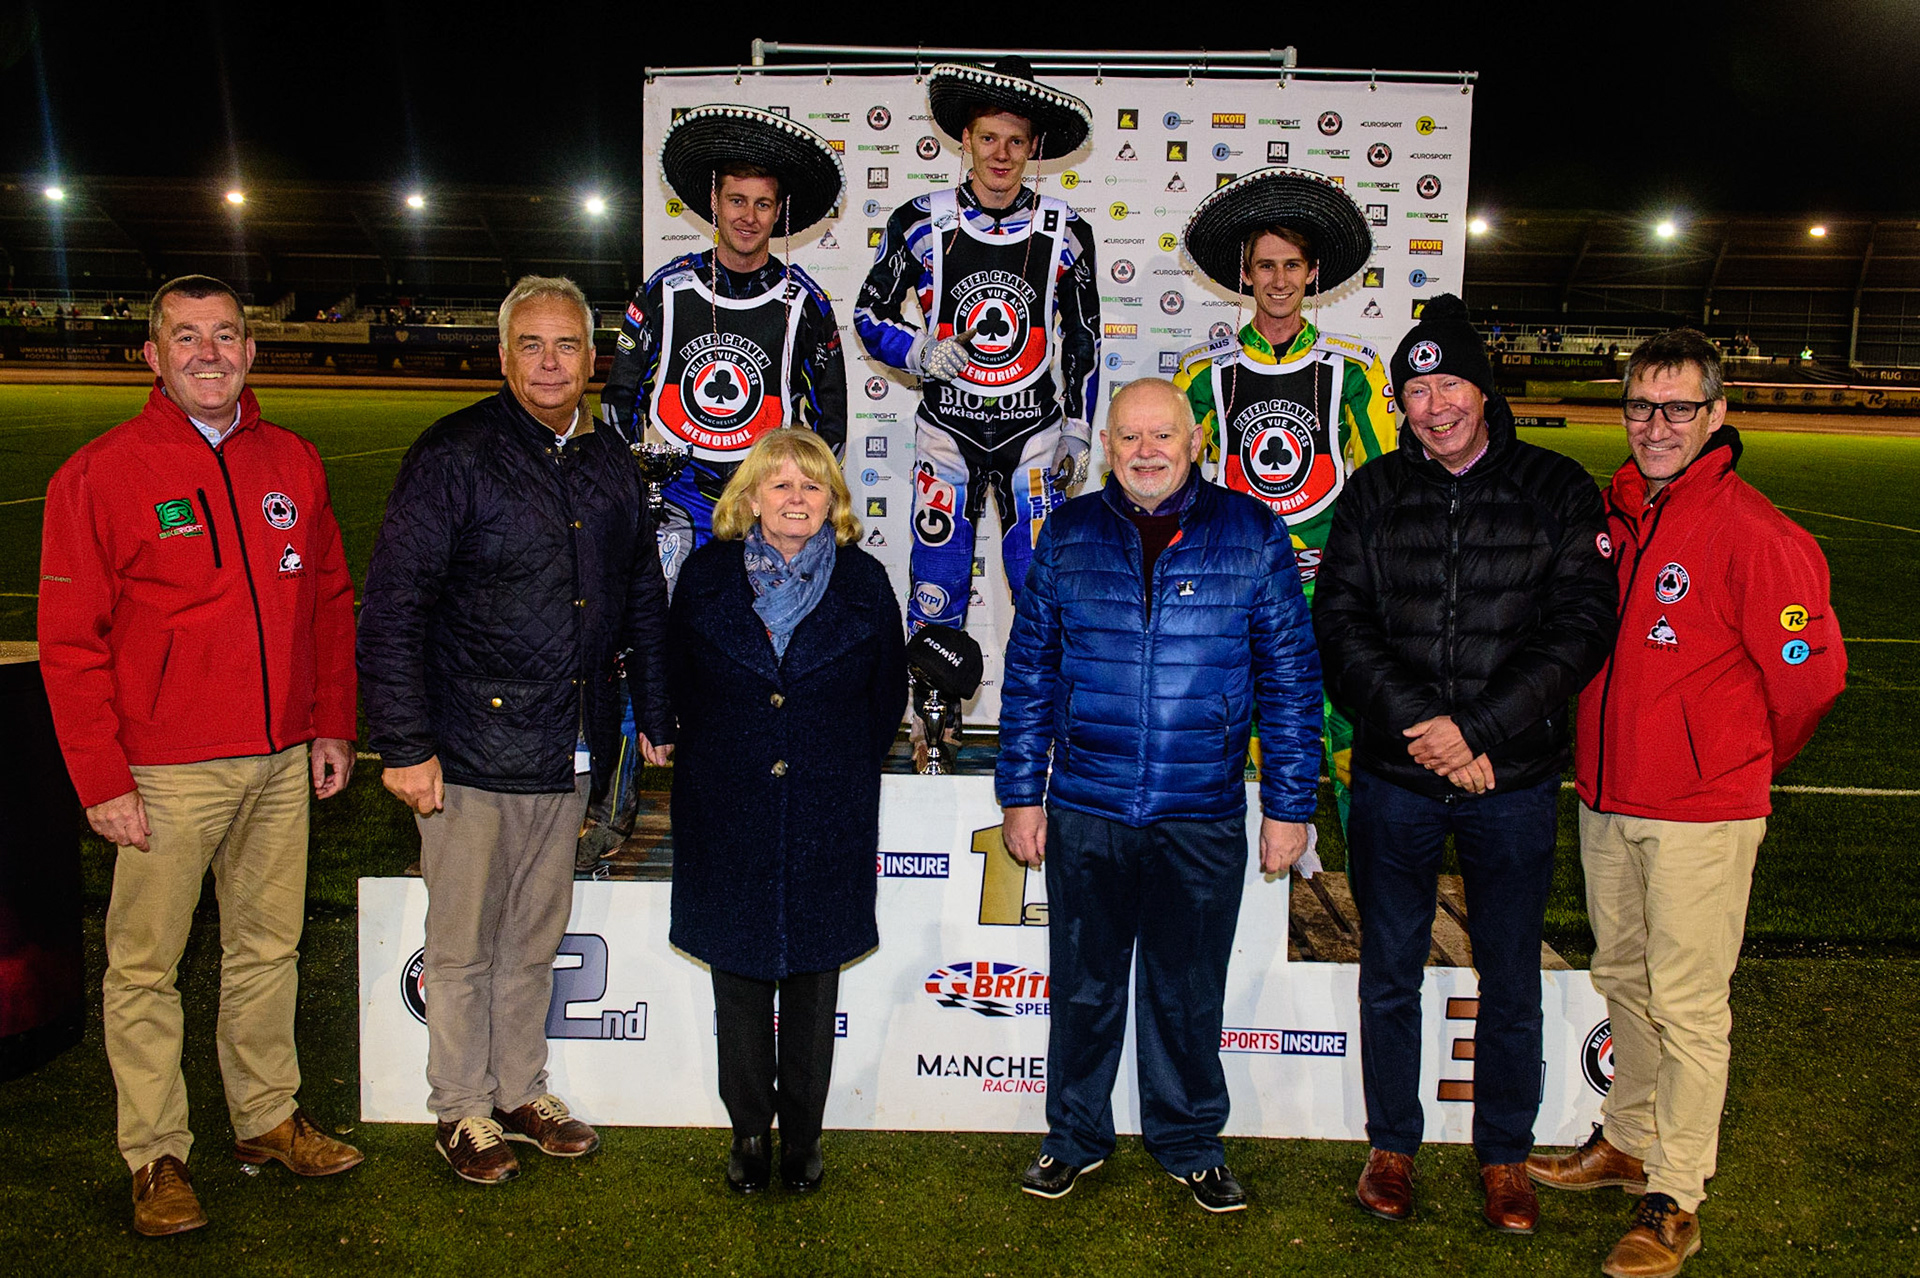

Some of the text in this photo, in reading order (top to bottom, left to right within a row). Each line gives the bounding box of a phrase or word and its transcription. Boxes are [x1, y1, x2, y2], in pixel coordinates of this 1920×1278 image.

[1213, 114, 1245, 124] HYCOTE
[1269, 143, 1288, 157] JBL
[868, 169, 887, 183] JBL
[1367, 204, 1387, 220] JBL
[1410, 240, 1442, 250] HYCOTE
[951, 270, 1037, 303] PETER CRAVEN
[959, 289, 1026, 320] BELLE VUE ACES
[1105, 325, 1137, 334] HYCOTE
[679, 332, 772, 369] PETER CRAVEN
[973, 352, 1010, 362] MANCHESTER
[687, 351, 759, 386] BELLE VUE ACES
[1534, 357, 1603, 367] bike-right.com
[963, 363, 1024, 382] EMORIAL
[1881, 371, 1902, 381] RUG
[939, 386, 1041, 411] BIO OIL
[699, 415, 738, 426] MANCHESTER
[1233, 399, 1319, 432] PETER CRAVEN
[681, 421, 753, 447] MEMORIAL
[1243, 418, 1309, 448] BELLE VUE ACES
[867, 438, 887, 452] JBL
[1258, 482, 1294, 492] MANCHESTER
[1029, 496, 1045, 519] plc
[917, 590, 941, 608] ATPI
[886, 856, 948, 876] INSURE
[973, 975, 1050, 998] BRITI
[1283, 1034, 1345, 1053] INSURE
[1591, 1028, 1611, 1049] BELL
[917, 1054, 1045, 1078] MANCHE
[982, 1079, 1045, 1093] RACING
